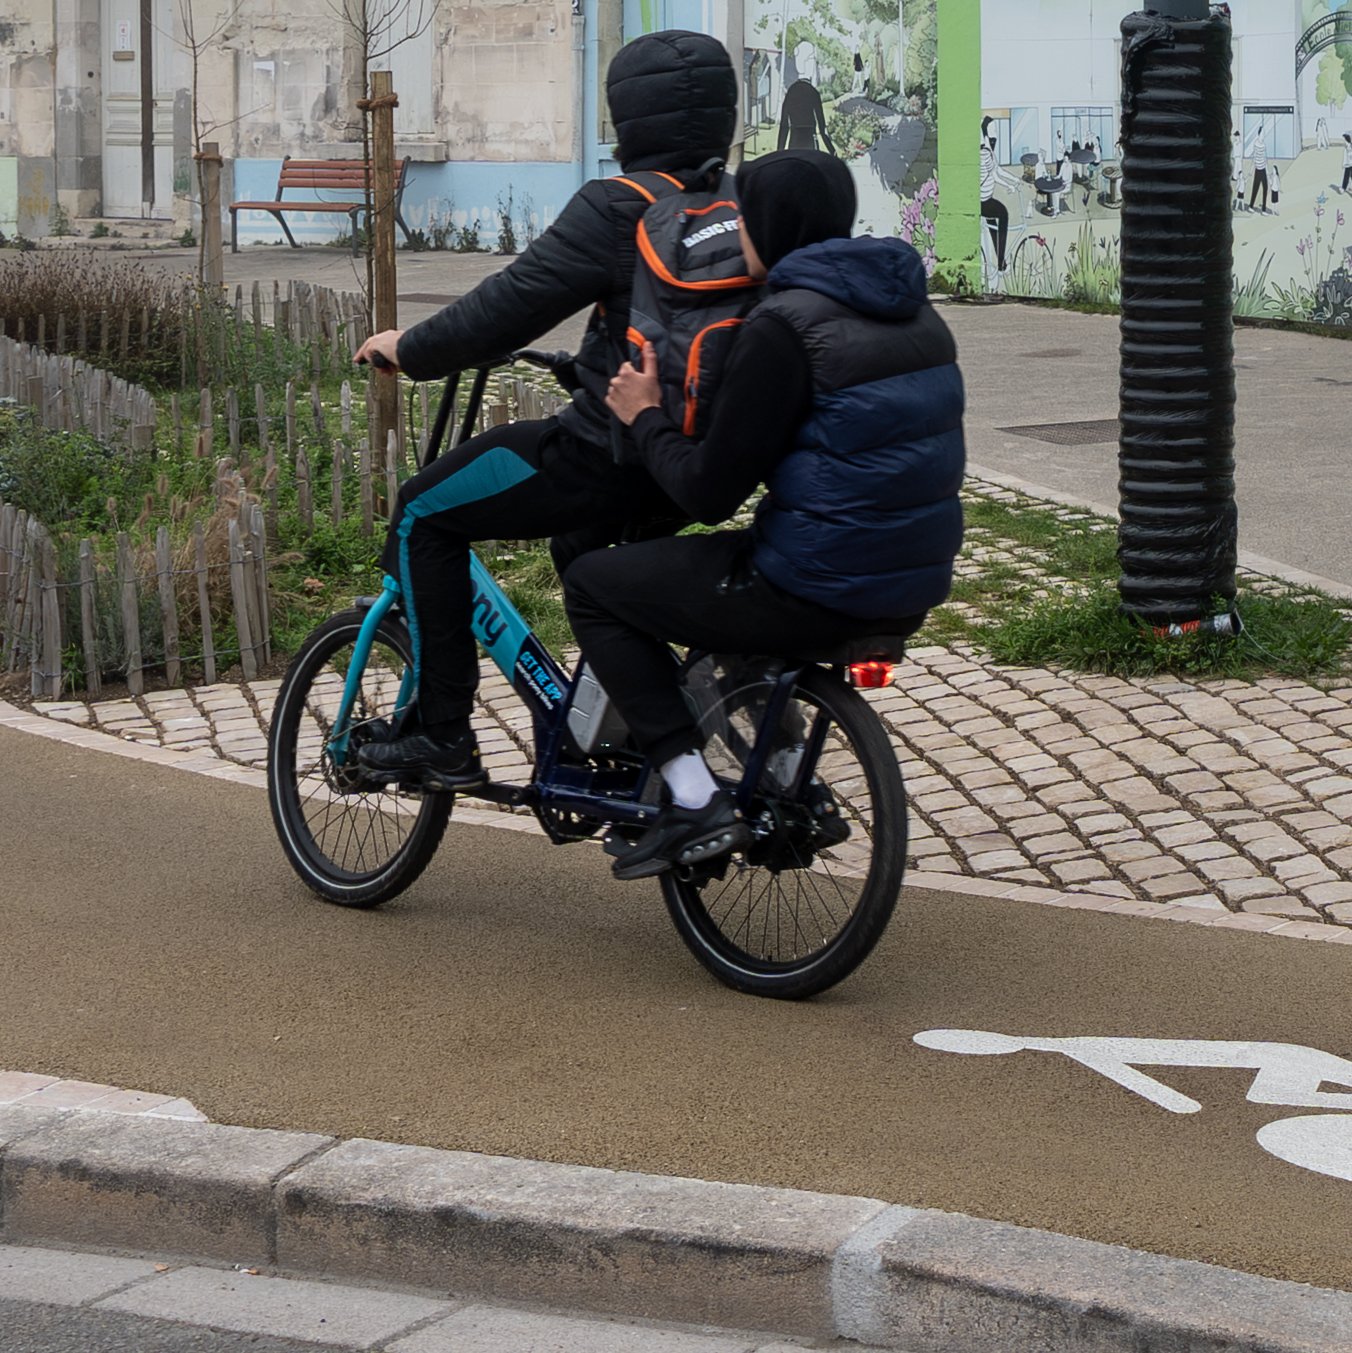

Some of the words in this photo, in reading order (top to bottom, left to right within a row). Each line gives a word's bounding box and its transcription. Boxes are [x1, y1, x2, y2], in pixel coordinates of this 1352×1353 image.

[682, 222, 726, 248] BASIC
[519, 651, 539, 670] GET
[532, 661, 550, 686] THE
[544, 682, 563, 700] APP
